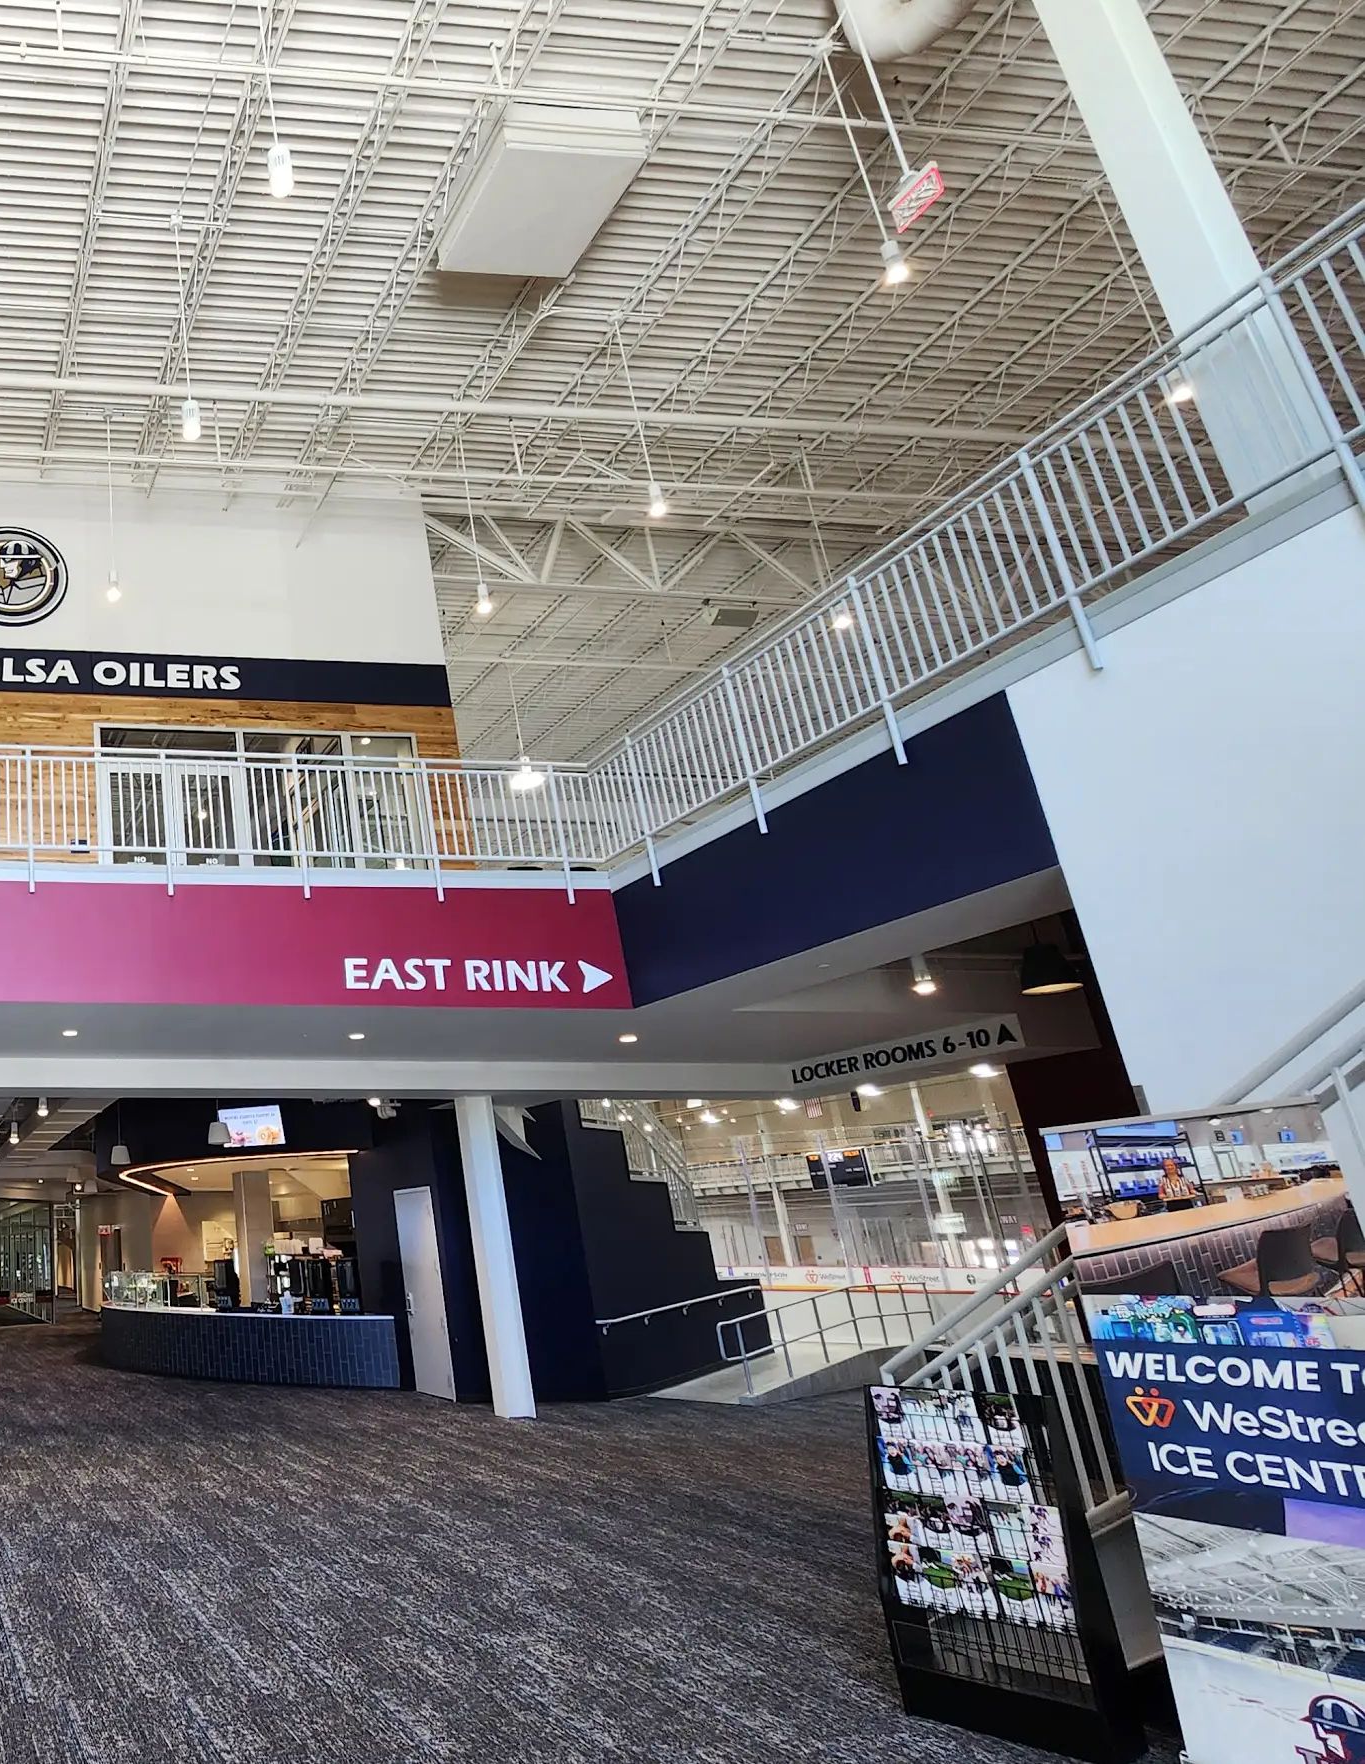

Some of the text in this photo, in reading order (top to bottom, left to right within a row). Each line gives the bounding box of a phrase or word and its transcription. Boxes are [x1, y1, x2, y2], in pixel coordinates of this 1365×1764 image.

[93, 660, 241, 691] OILERS
[344, 957, 571, 993] EAST RINK
[791, 1028, 991, 1084] LOCKER ROOMS 6-10
[1104, 1350, 1365, 1395] WELCOME T
[1182, 1399, 1365, 1447] WeStre
[1147, 1441, 1219, 1480] ICE
